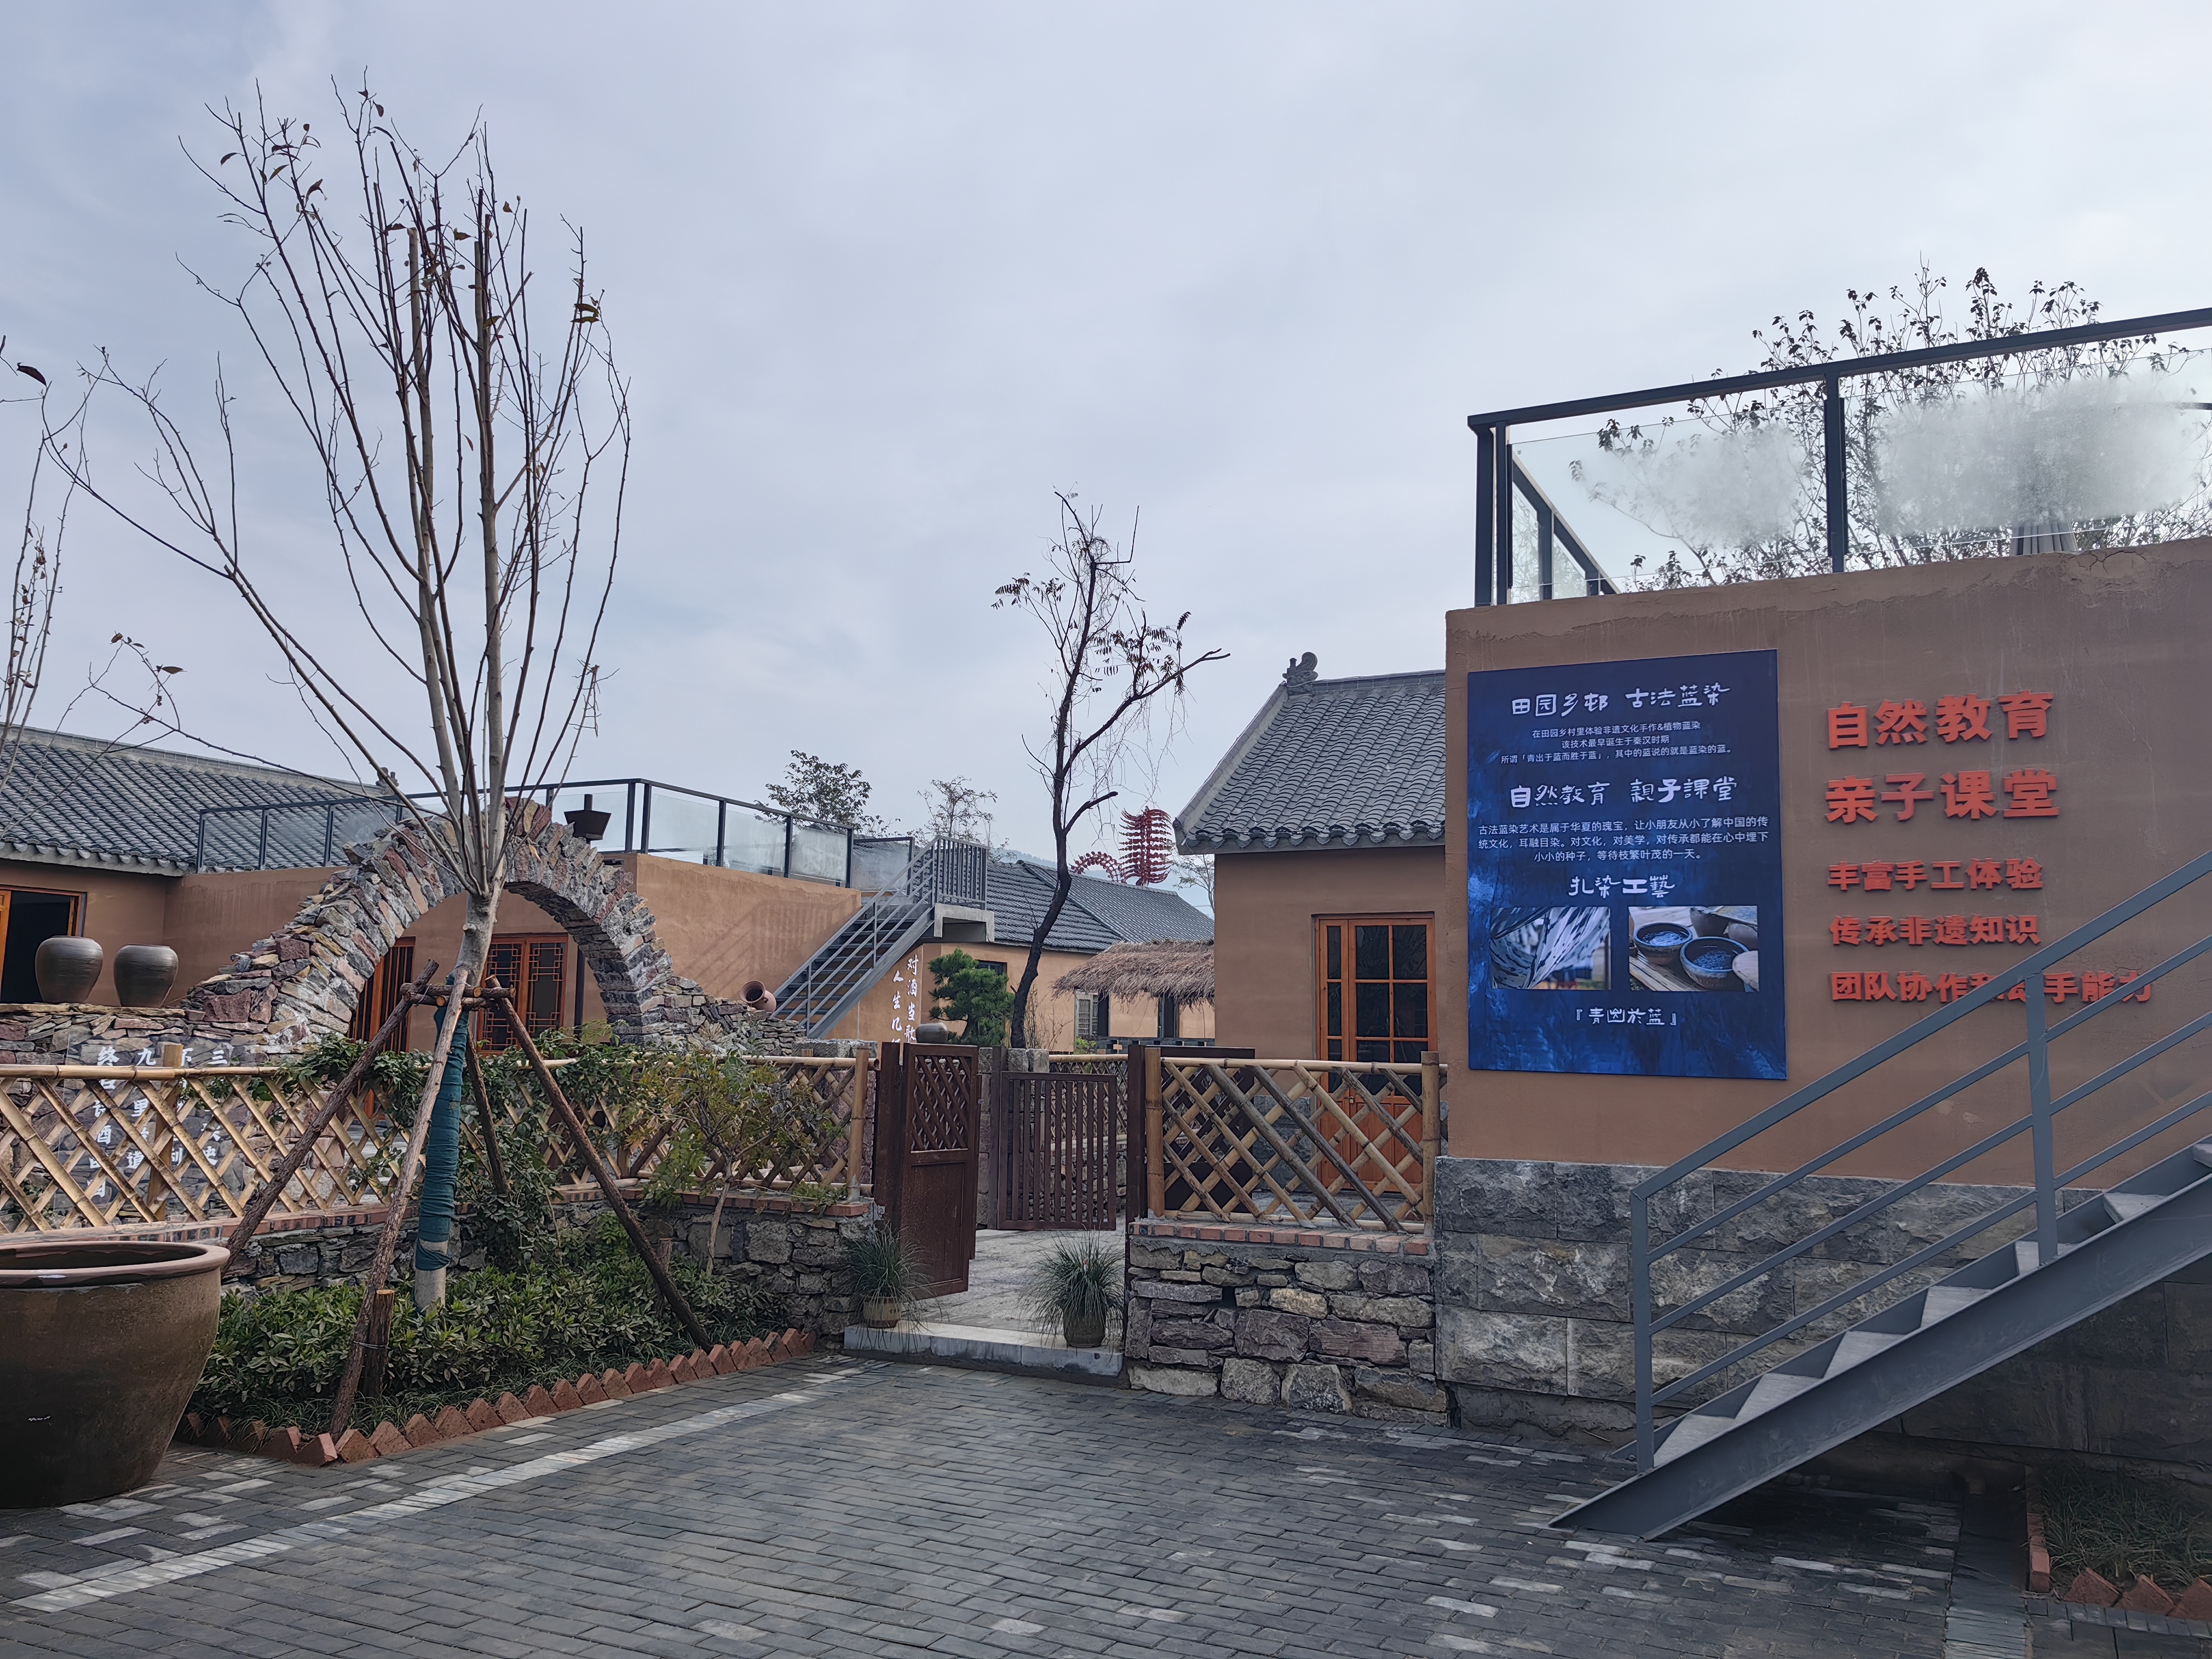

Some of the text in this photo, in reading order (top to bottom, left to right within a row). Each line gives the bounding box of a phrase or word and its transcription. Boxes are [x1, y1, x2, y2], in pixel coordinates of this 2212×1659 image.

[1626, 682, 1730, 709] 古法蓝染
[1532, 721, 1701, 739] 在田园乡村里体验非遗文化手作&植物蓝染
[1827, 690, 2053, 750] 自然教育
[1562, 735, 1670, 749] 该技术最早诞生于秦汉时期
[1510, 781, 1610, 807] 自然教育
[1824, 768, 2060, 824] 亲子课堂
[1478, 816, 1769, 835] 古法蓝染艺术是属于华夏的瑰宝，让小朋友从小了解中国的传
[1478, 831, 1769, 849] 统文化，耳融目染。对文化，对美学，对传承都能在心中埋下
[1534, 848, 1701, 862] 小小的种子，等待枝繁叶茂的一天。
[1828, 857, 2043, 891] 丰富手工体验
[1829, 914, 2041, 946] 传承非遗知识
[891, 970, 904, 1043] 人生几
[904, 954, 919, 1043] 对酒当歌
